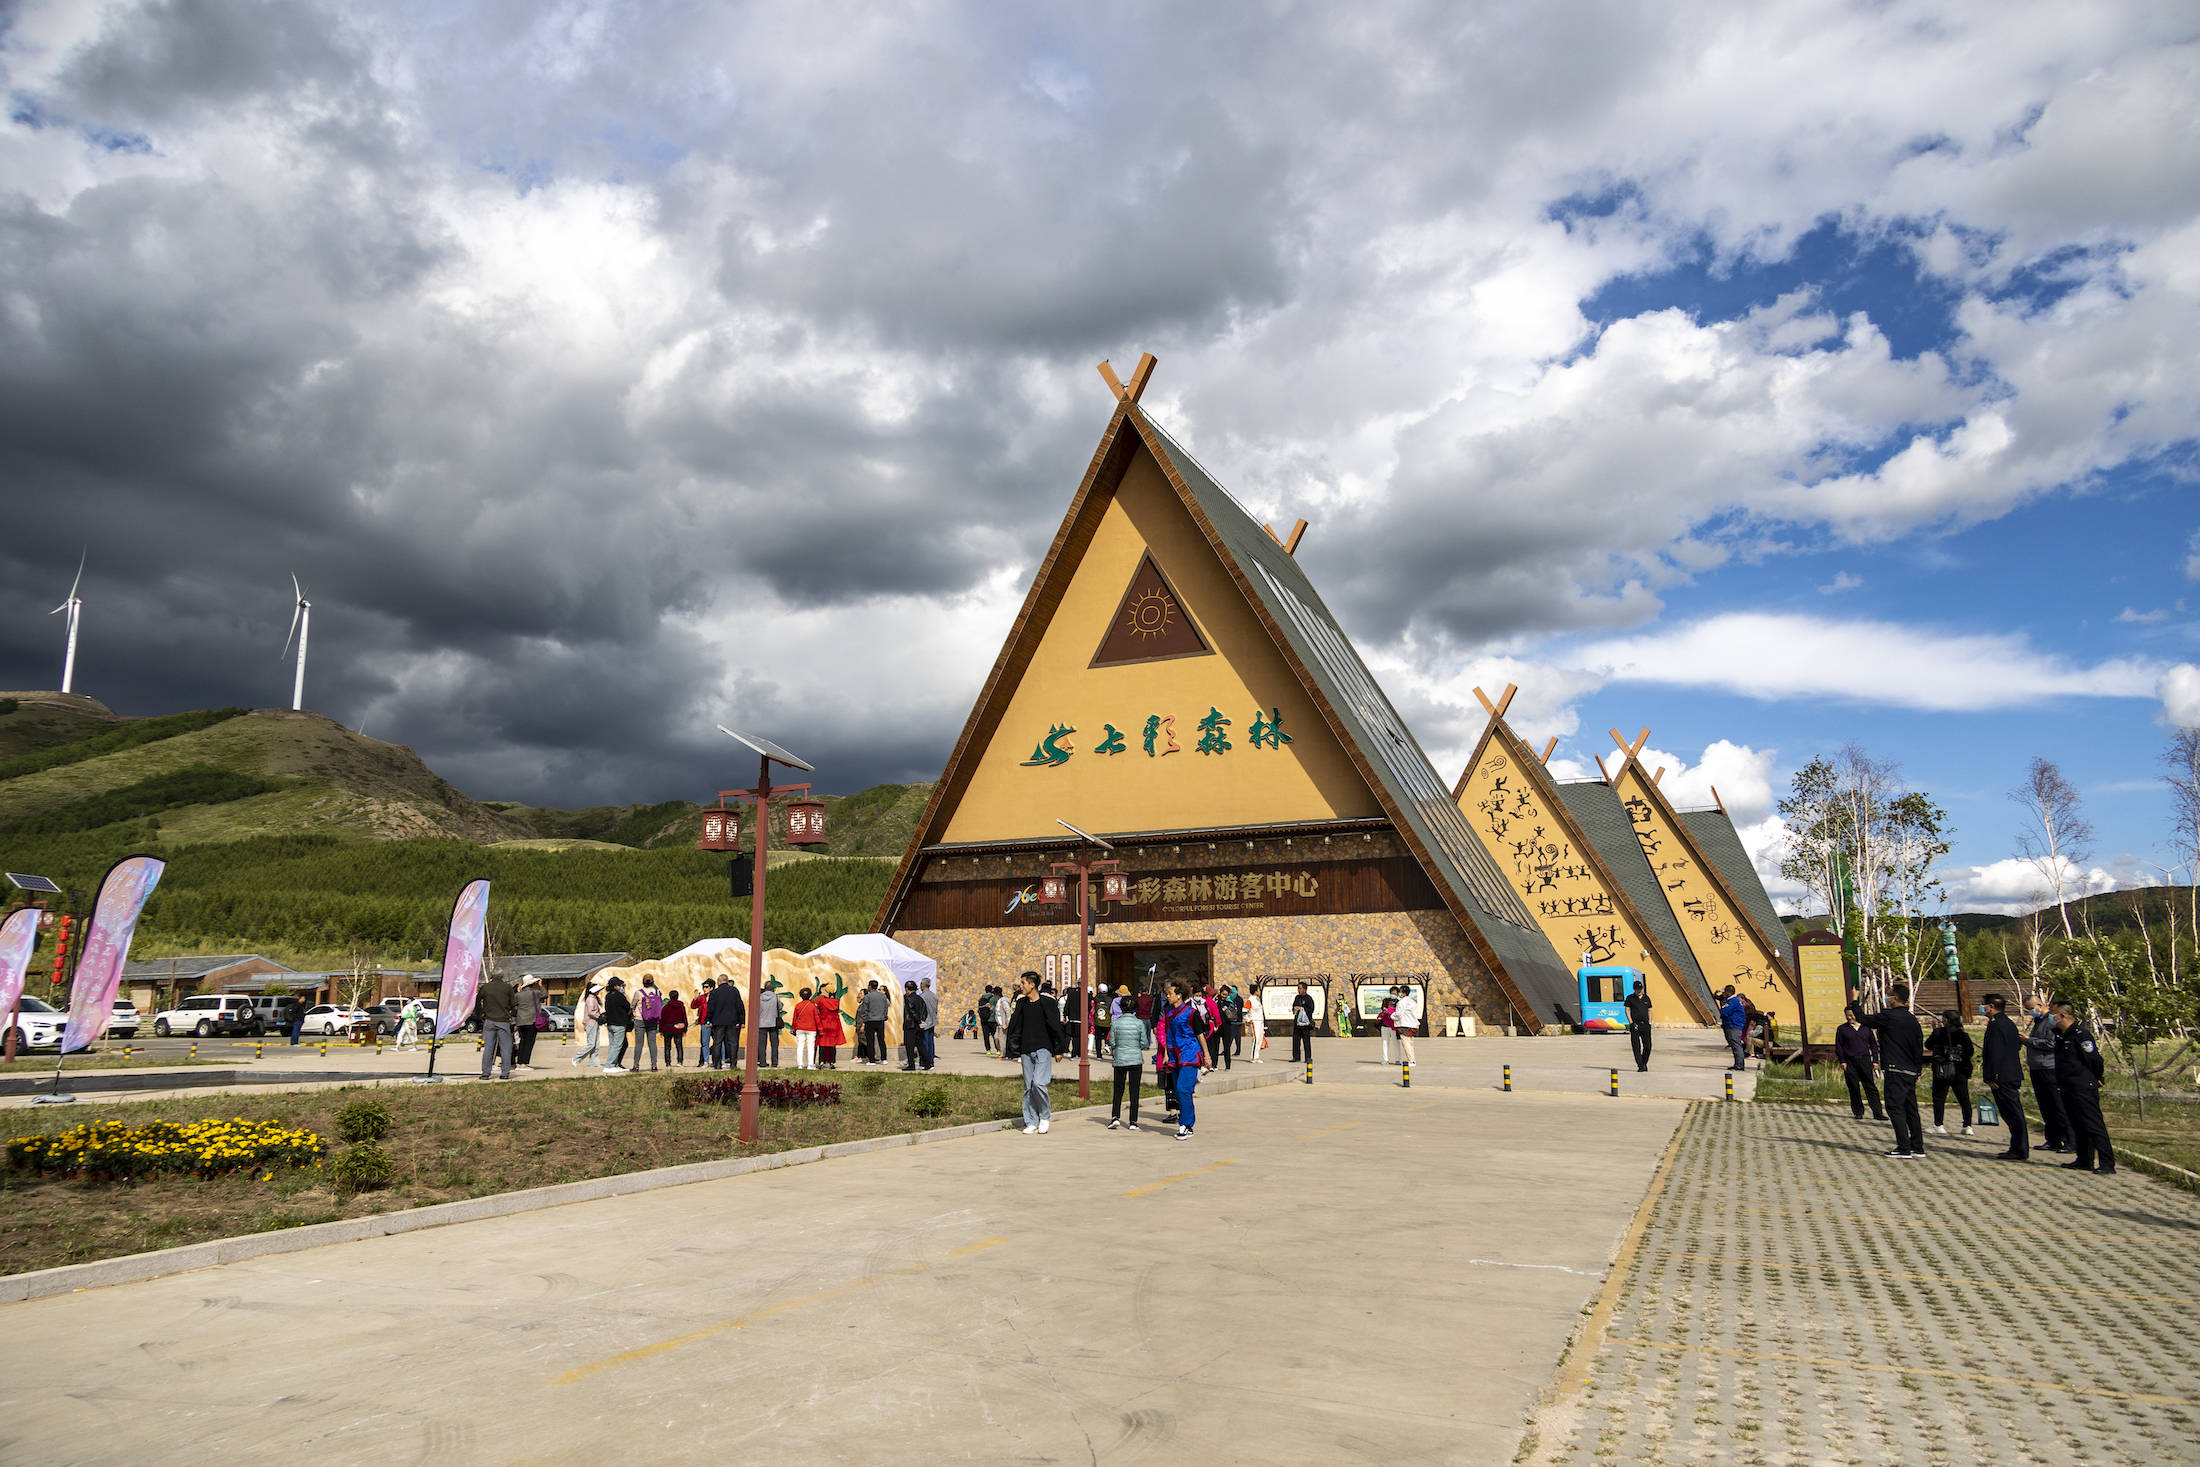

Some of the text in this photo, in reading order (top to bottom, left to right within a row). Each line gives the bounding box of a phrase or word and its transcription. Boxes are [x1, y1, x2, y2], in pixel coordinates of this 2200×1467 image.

[1094, 707, 1294, 757] 七彩森林
[1120, 871, 1319, 906] 七彩森林游客中心
[1162, 905, 1194, 913] COLORFUL
[1195, 904, 1216, 912] FOREST
[1240, 902, 1265, 910] CENTER
